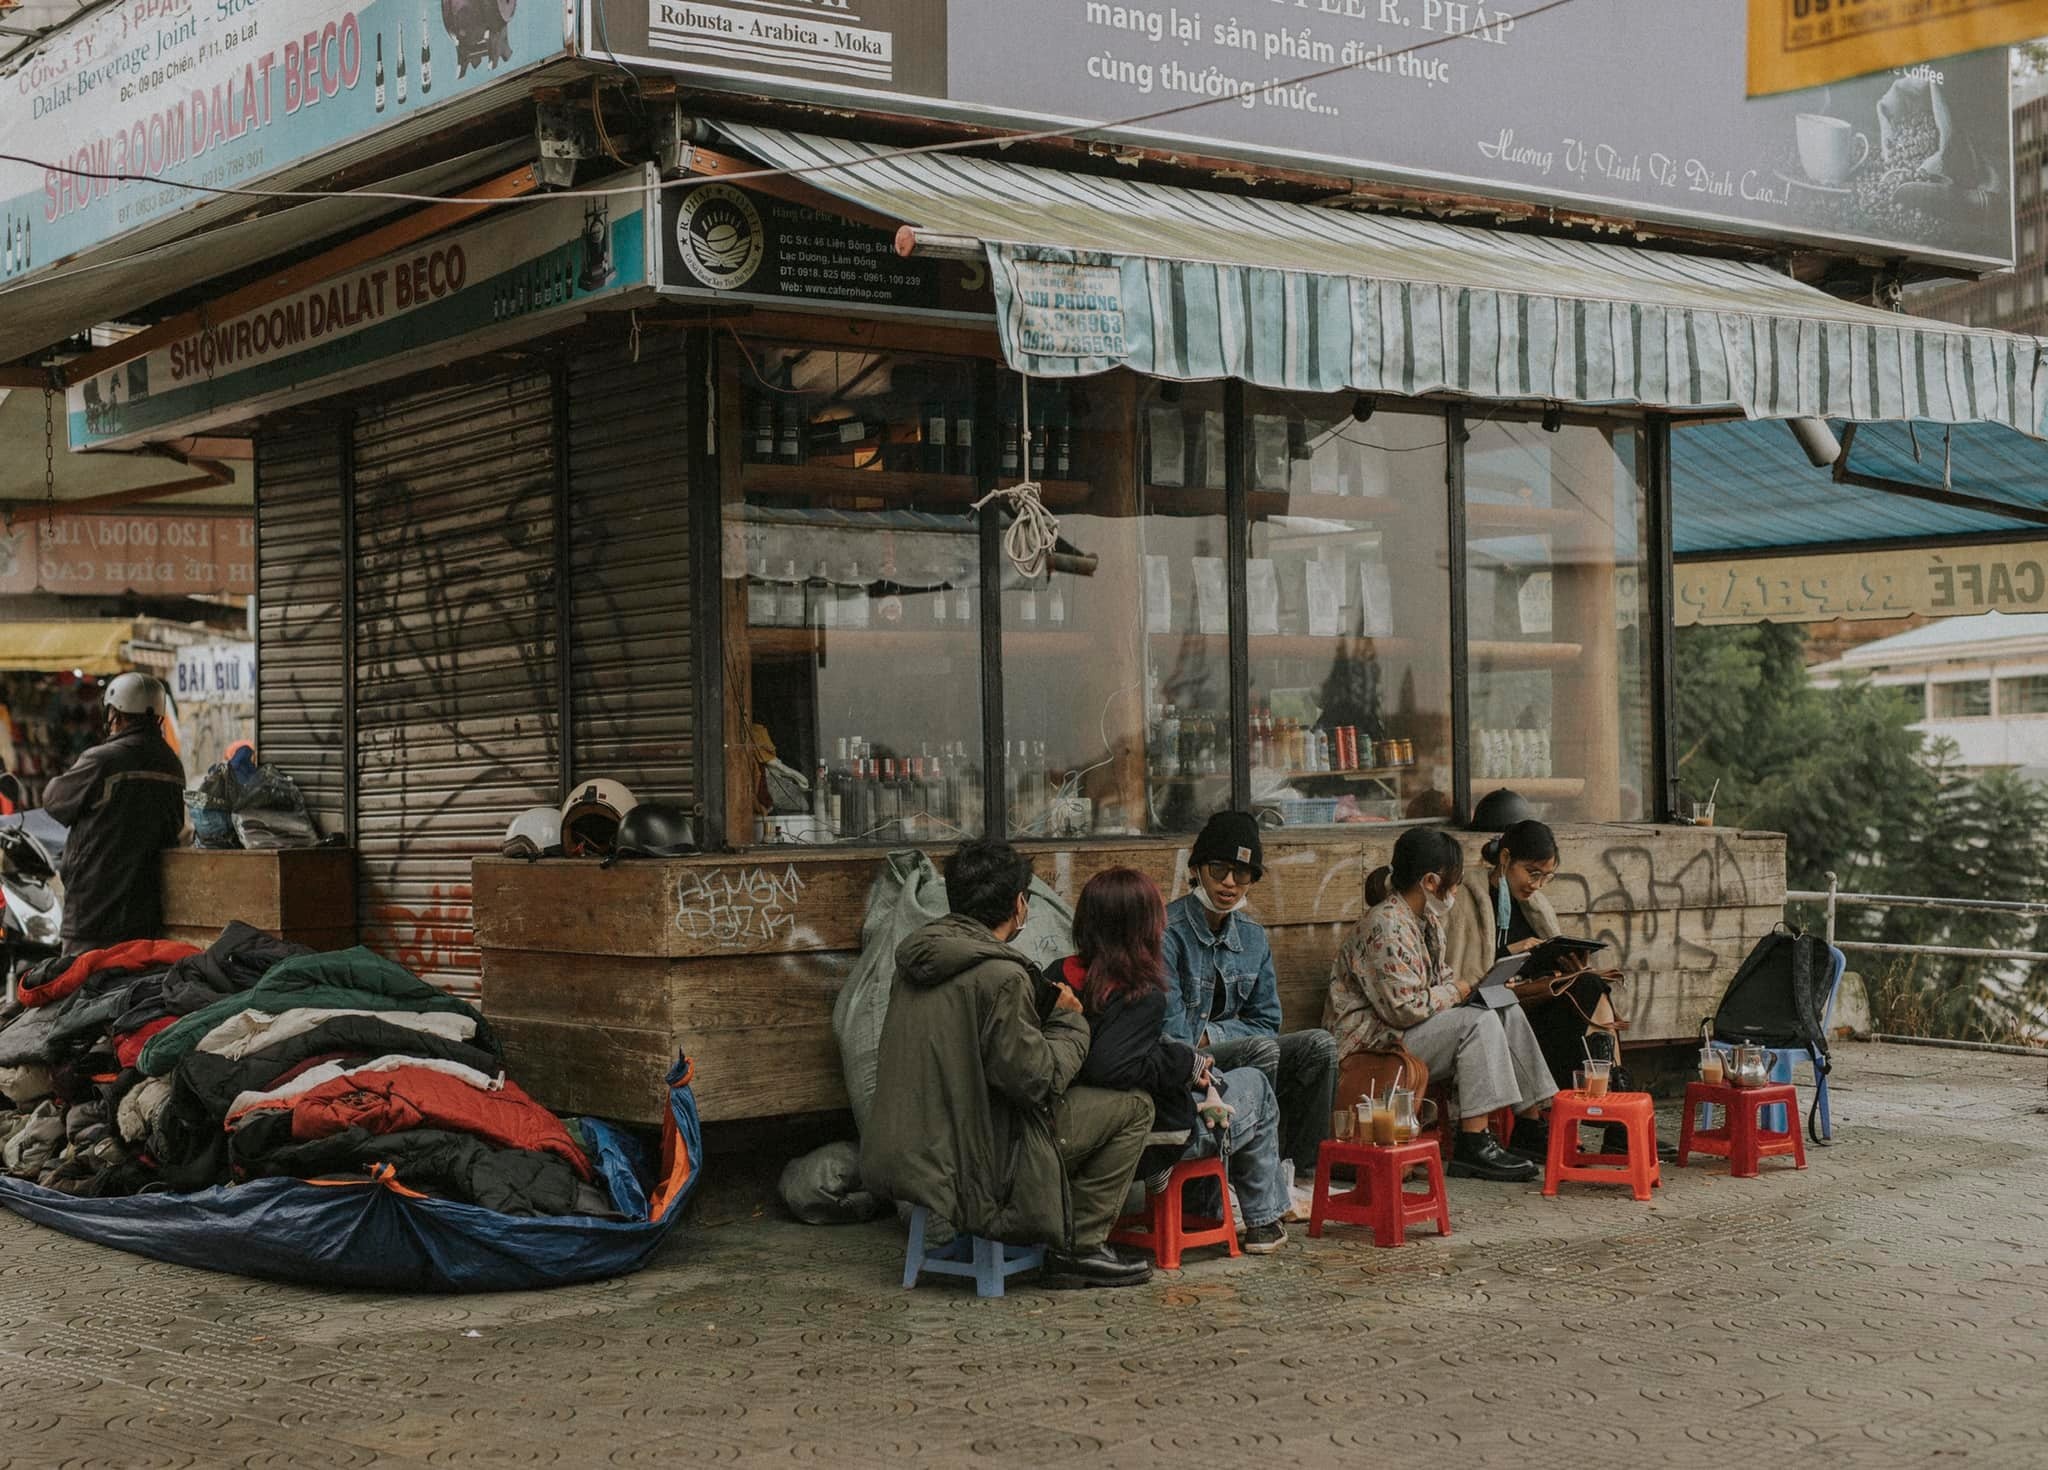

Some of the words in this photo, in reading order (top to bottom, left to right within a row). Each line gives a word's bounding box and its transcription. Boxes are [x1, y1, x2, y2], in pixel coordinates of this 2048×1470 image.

[660, 4, 733, 33] Robusta
[750, 18, 817, 45] Arabica
[834, 31, 882, 56] Moka
[1086, 1, 1163, 42] mang
[1170, 7, 1200, 47] lại
[1213, 17, 1257, 50] sản
[1264, 27, 1335, 63] phẩm
[1341, 39, 1392, 73] đích
[1397, 49, 1449, 88] thực
[1420, 0, 1515, 45] PHÁP
[33, 43, 150, 120] Dalat-Beverage
[155, 14, 197, 60] Joint
[139, 73, 150, 93] 09
[225, 30, 238, 50] Đà
[241, 20, 258, 42] Lạt
[191, 52, 275, 158] DALAT
[284, 12, 361, 115] BECO
[1086, 51, 1153, 94] cùng
[1160, 61, 1256, 109] thưởng
[1263, 77, 1339, 116] thức...
[1562, 138, 1588, 182] Vị
[1595, 143, 1641, 183] Tinh
[780, 265, 796, 276] ĐT:
[889, 274, 904, 285] 100
[780, 281, 803, 292] Web:
[170, 301, 305, 380] SHOWROOM
[309, 270, 388, 337] DALAT
[395, 244, 466, 310] BECO
